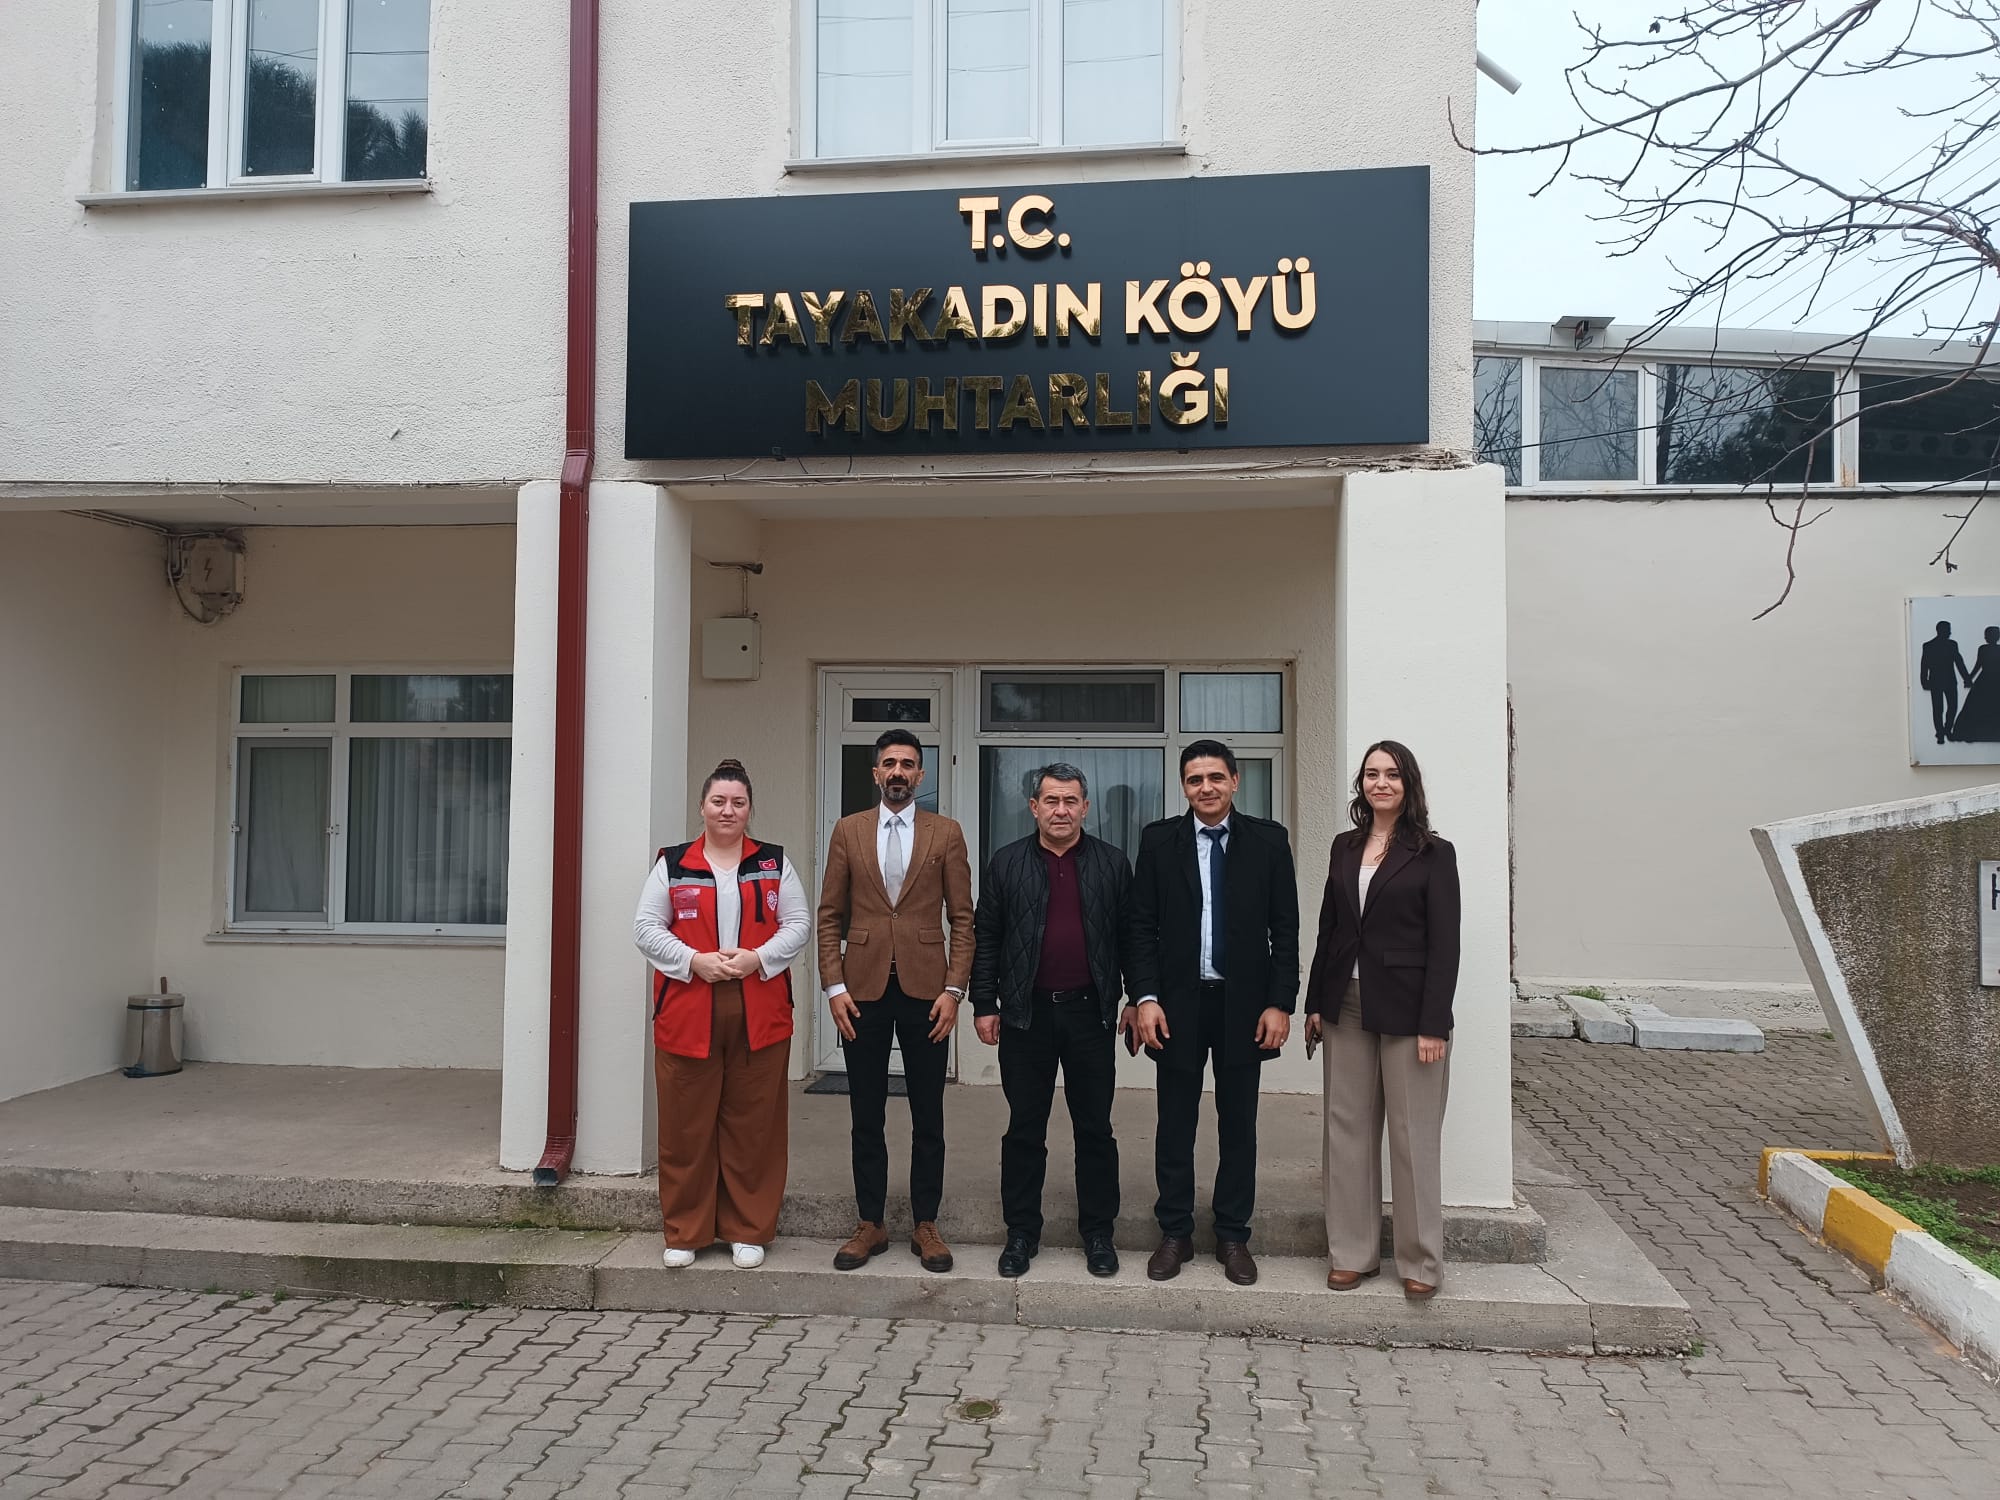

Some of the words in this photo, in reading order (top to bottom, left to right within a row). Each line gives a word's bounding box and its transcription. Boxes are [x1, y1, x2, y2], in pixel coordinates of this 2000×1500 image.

[958, 194, 1071, 251] T.C.
[725, 283, 1101, 347] TAYAKADIN
[1124, 257, 1317, 334] KÖYÜ
[805, 350, 1229, 433] MUHTARLIĞI
